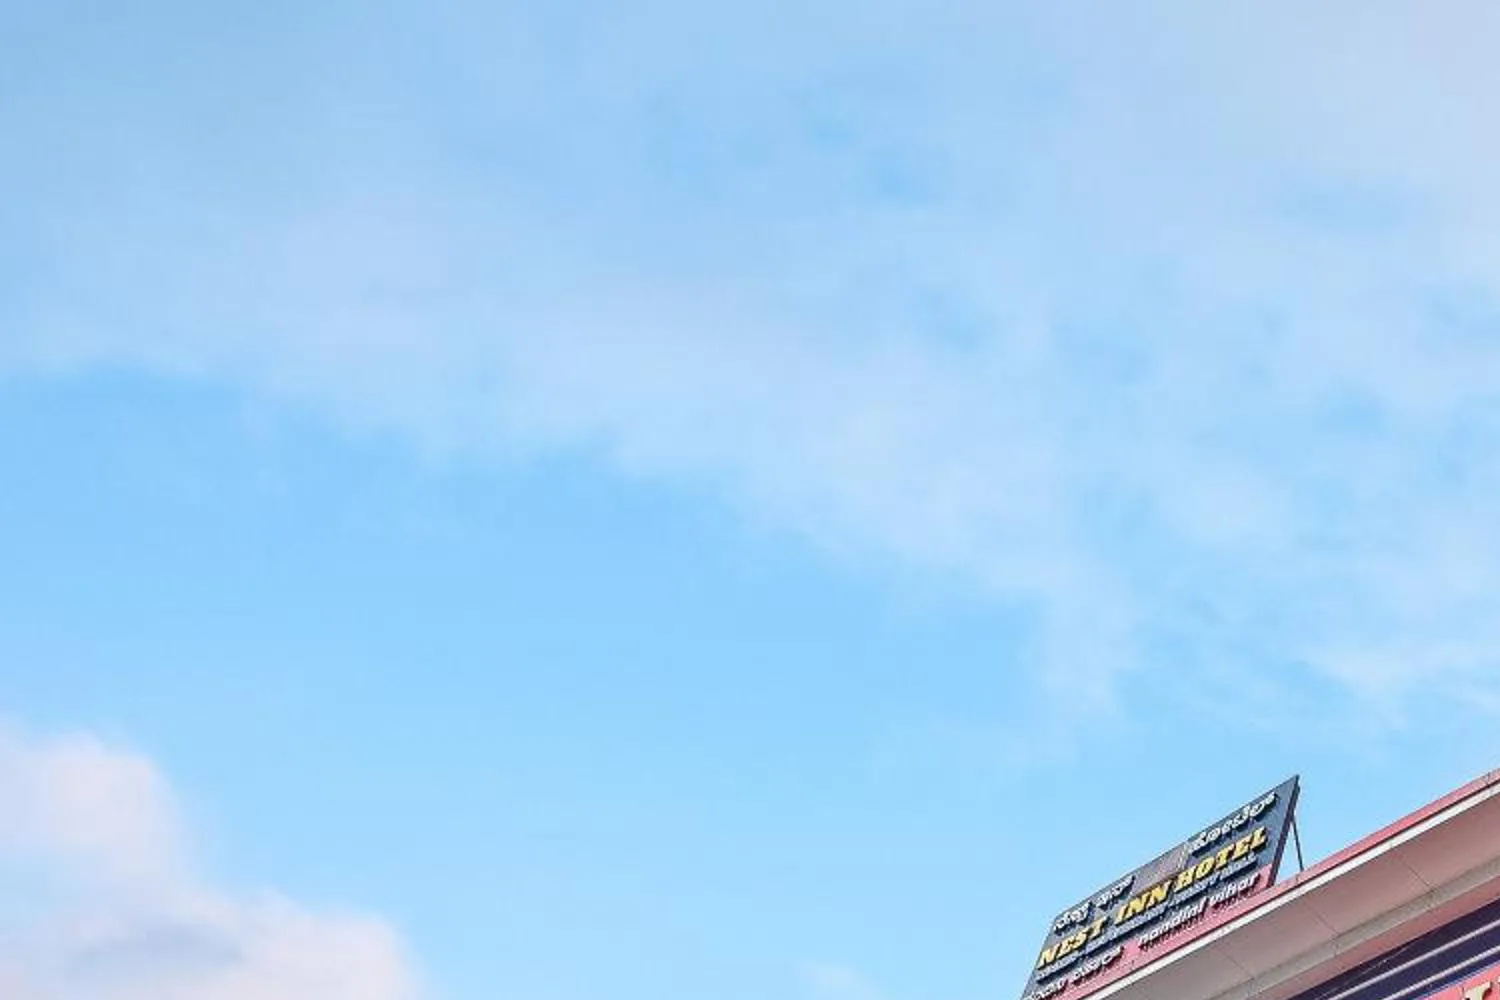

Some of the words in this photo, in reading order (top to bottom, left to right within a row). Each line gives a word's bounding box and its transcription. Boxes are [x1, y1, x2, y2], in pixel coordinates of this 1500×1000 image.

[1037, 916, 1109, 970] NEST
[1114, 881, 1172, 926] INN
[1174, 825, 1267, 893] HOTEL
